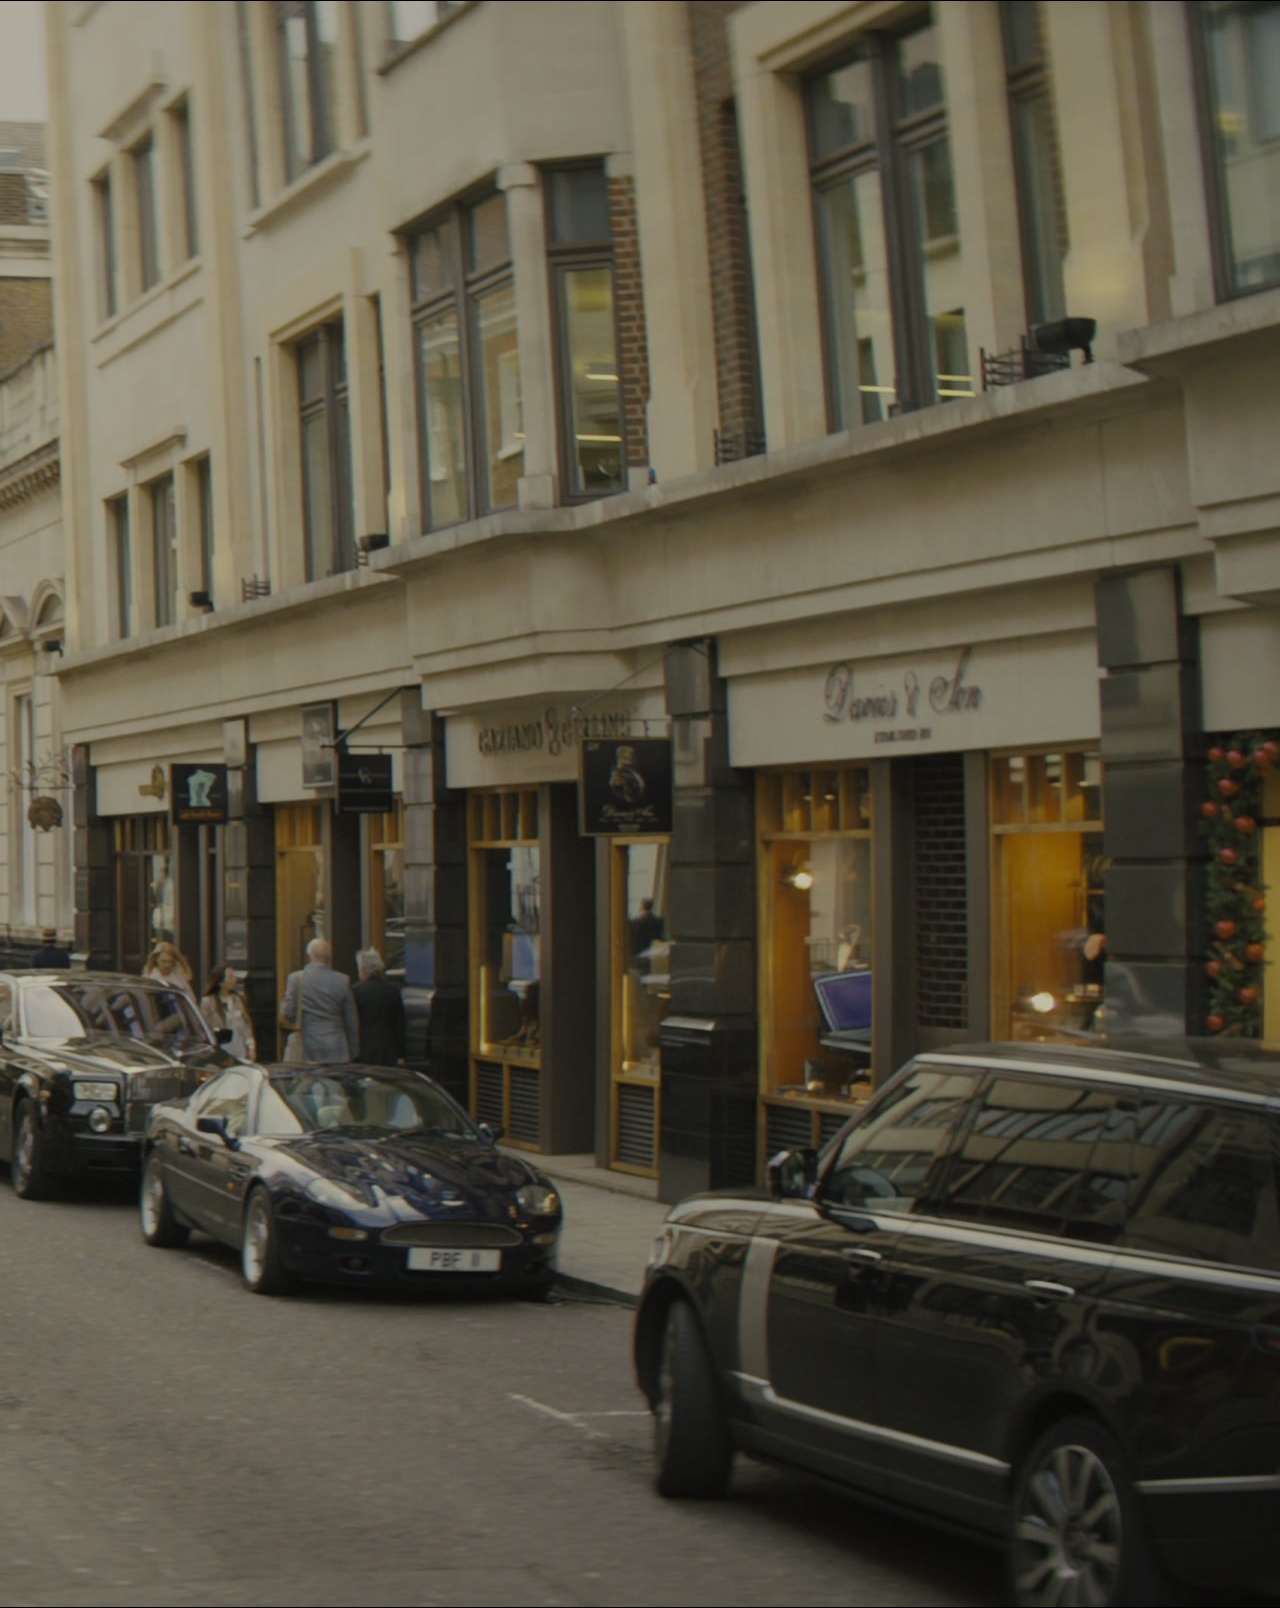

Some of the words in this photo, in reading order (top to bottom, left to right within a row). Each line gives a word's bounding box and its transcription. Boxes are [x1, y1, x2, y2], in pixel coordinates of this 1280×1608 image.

[904, 670, 920, 718] &
[929, 646, 982, 713] Son
[478, 721, 544, 756] GAZIANO
